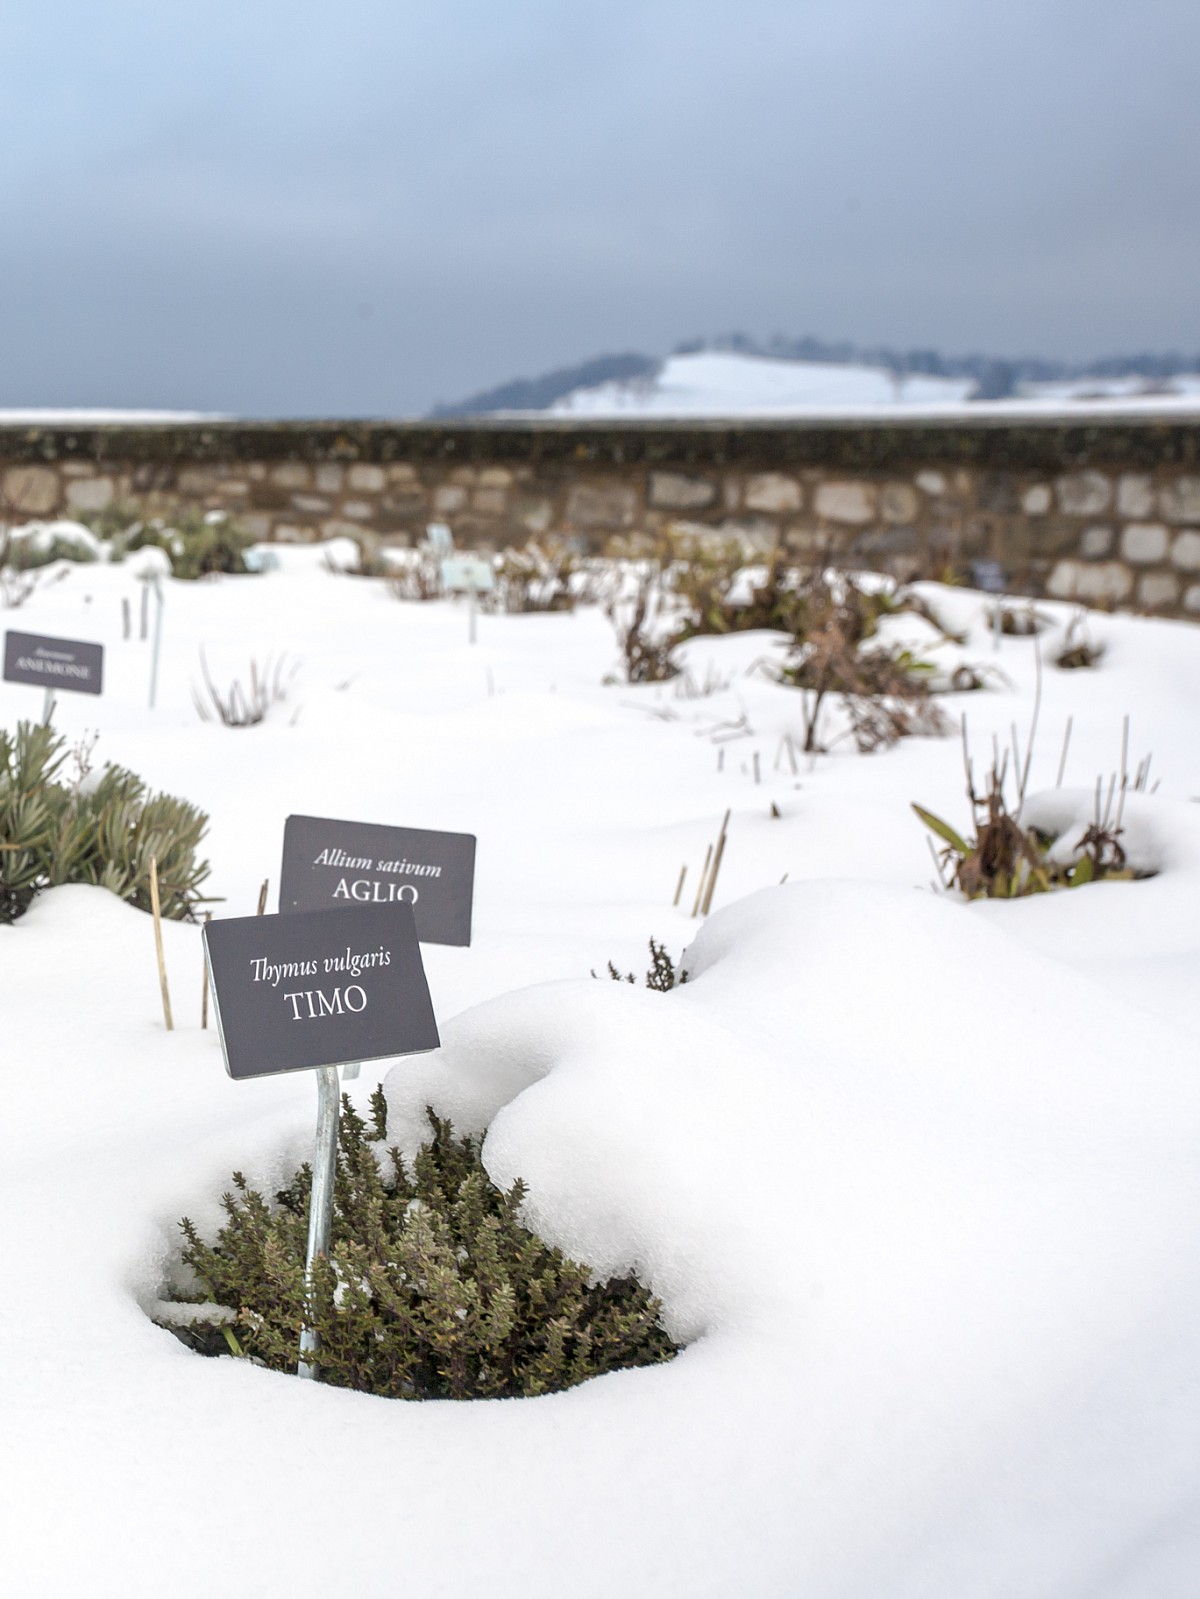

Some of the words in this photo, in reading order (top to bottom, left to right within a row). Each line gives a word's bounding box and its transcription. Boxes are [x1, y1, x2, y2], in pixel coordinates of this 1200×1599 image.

[15, 656, 92, 680] ANEMONE
[313, 848, 373, 871] Allium
[375, 858, 443, 878] sativum
[332, 877, 419, 906] AGLIO
[250, 955, 318, 987] Thymus
[323, 945, 392, 977] vulgaris
[283, 984, 368, 1021] TIMO
